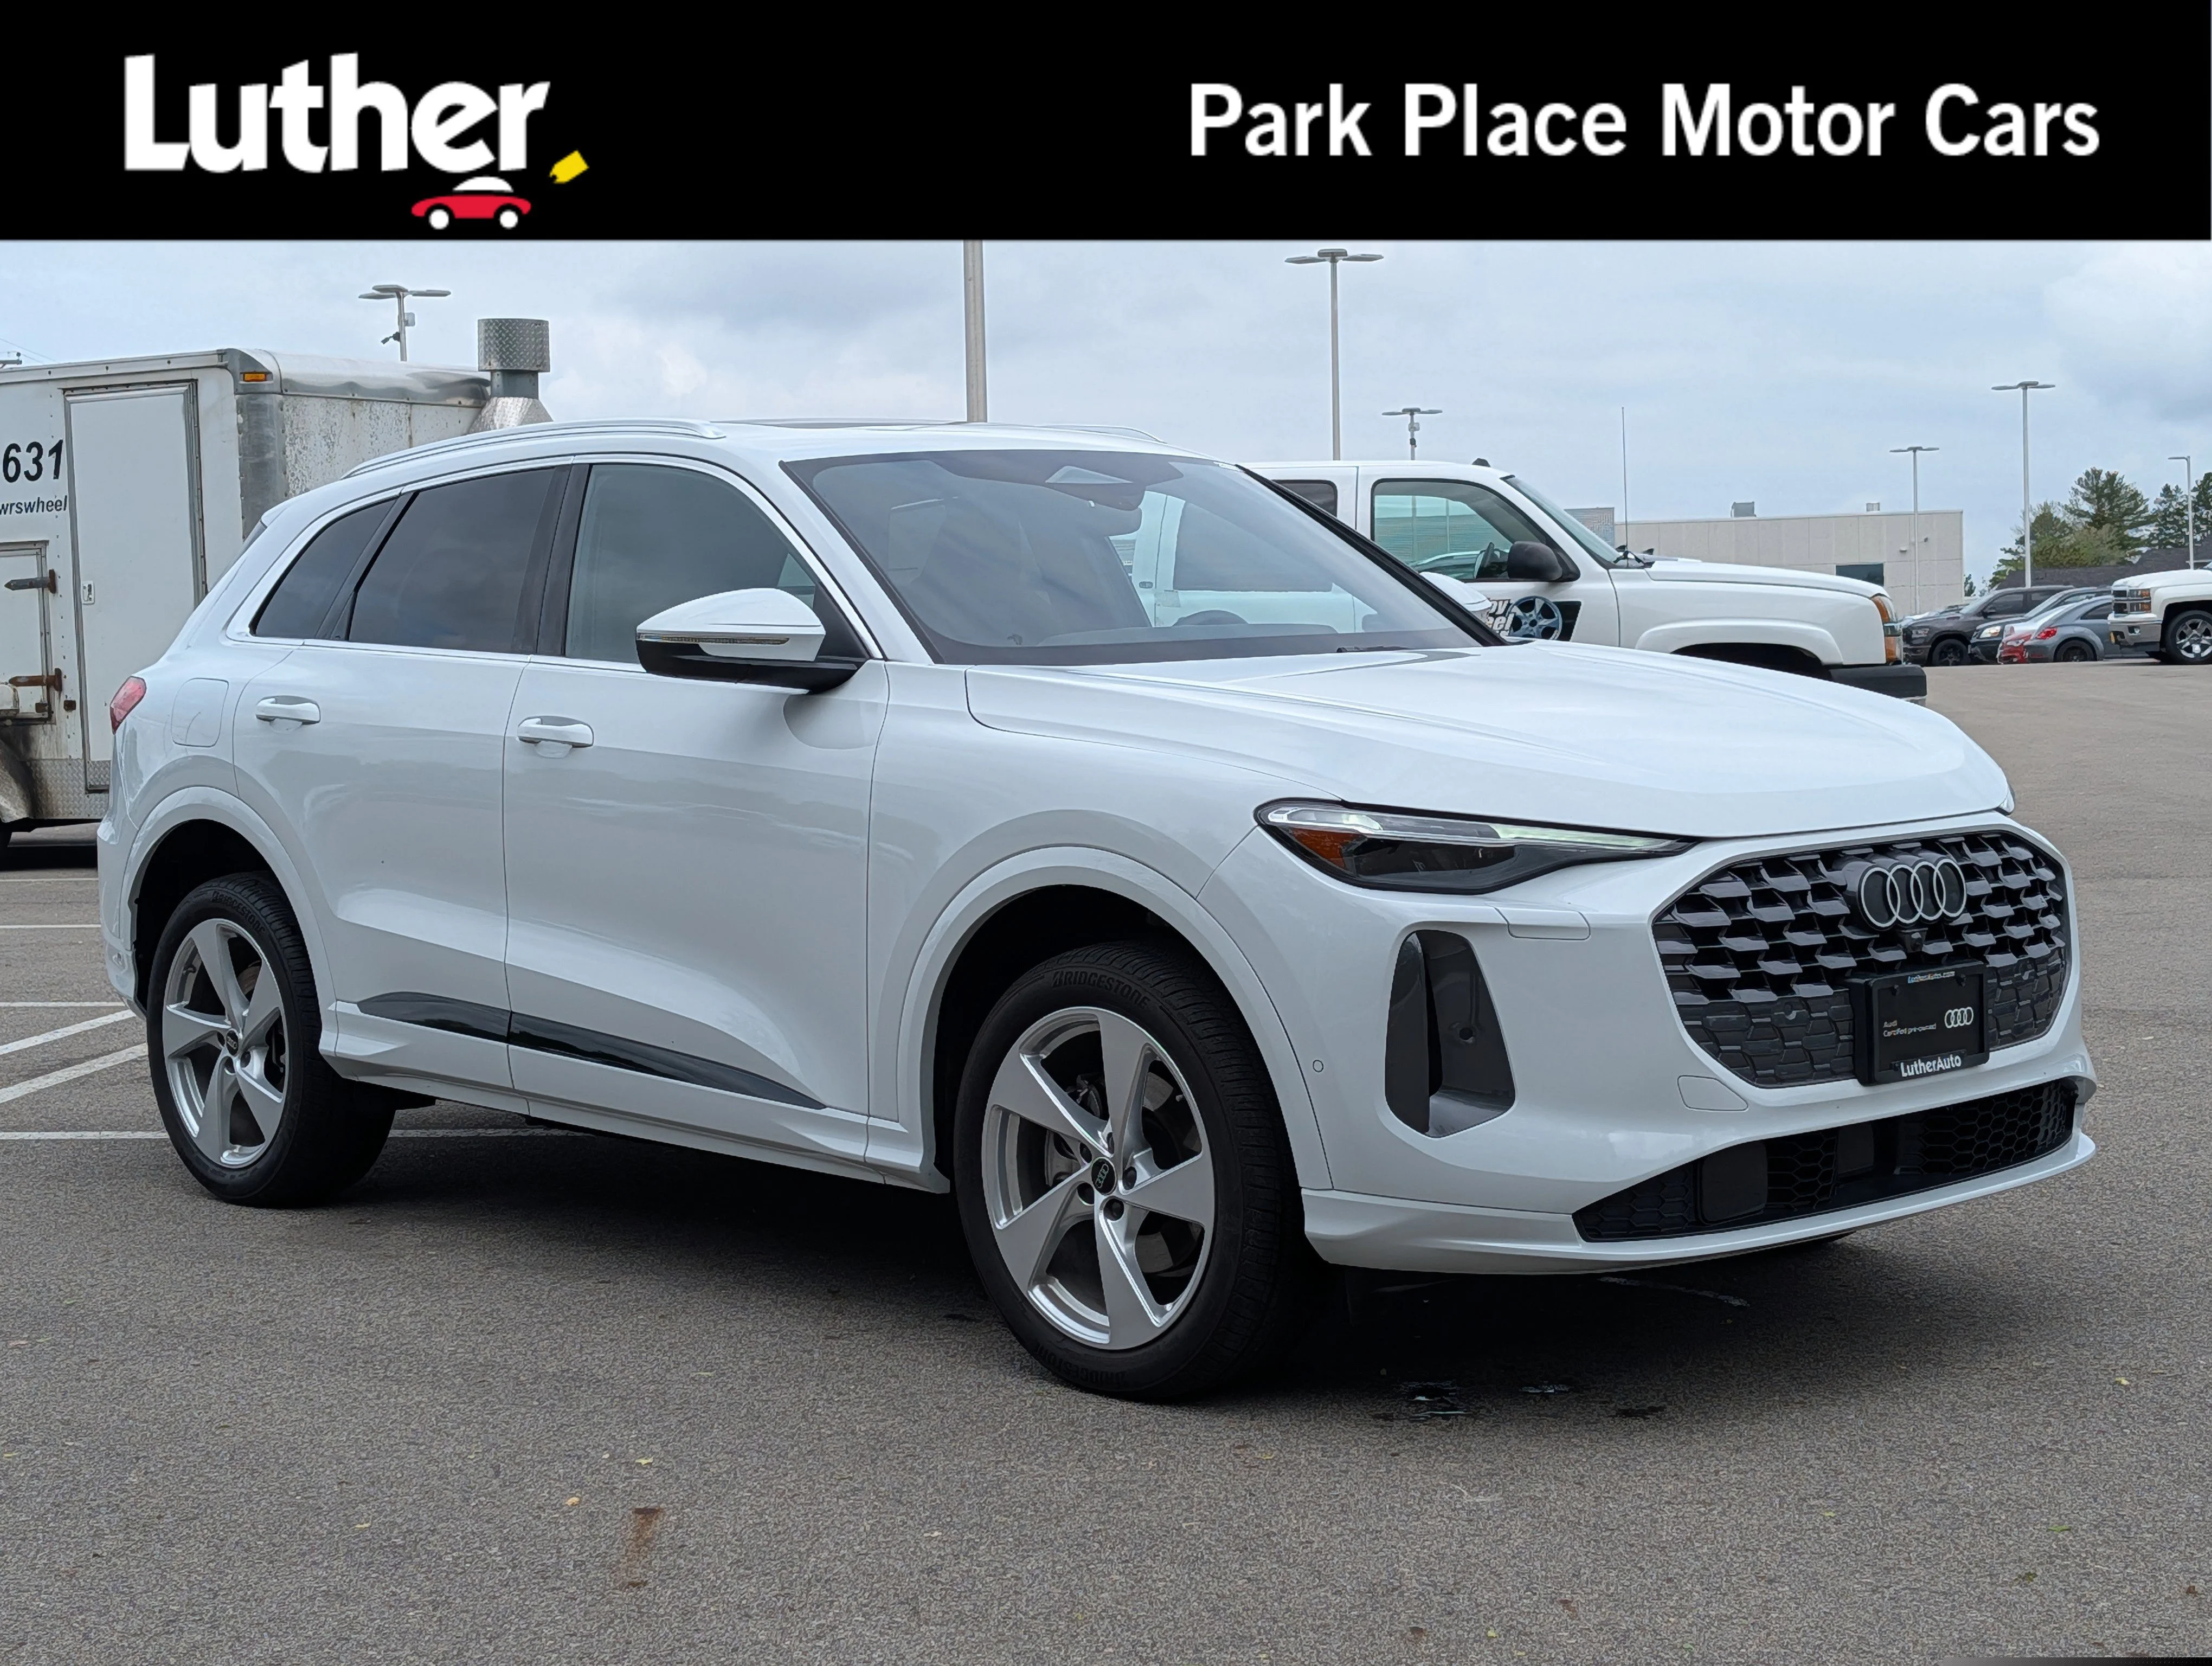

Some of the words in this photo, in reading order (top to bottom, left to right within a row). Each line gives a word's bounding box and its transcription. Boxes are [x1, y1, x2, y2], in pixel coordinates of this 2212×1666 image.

[3, 439, 63, 483] 631
[1052, 971, 1151, 1009] BRIDGESTONE
[1900, 1054, 1962, 1077] LutherAuto
